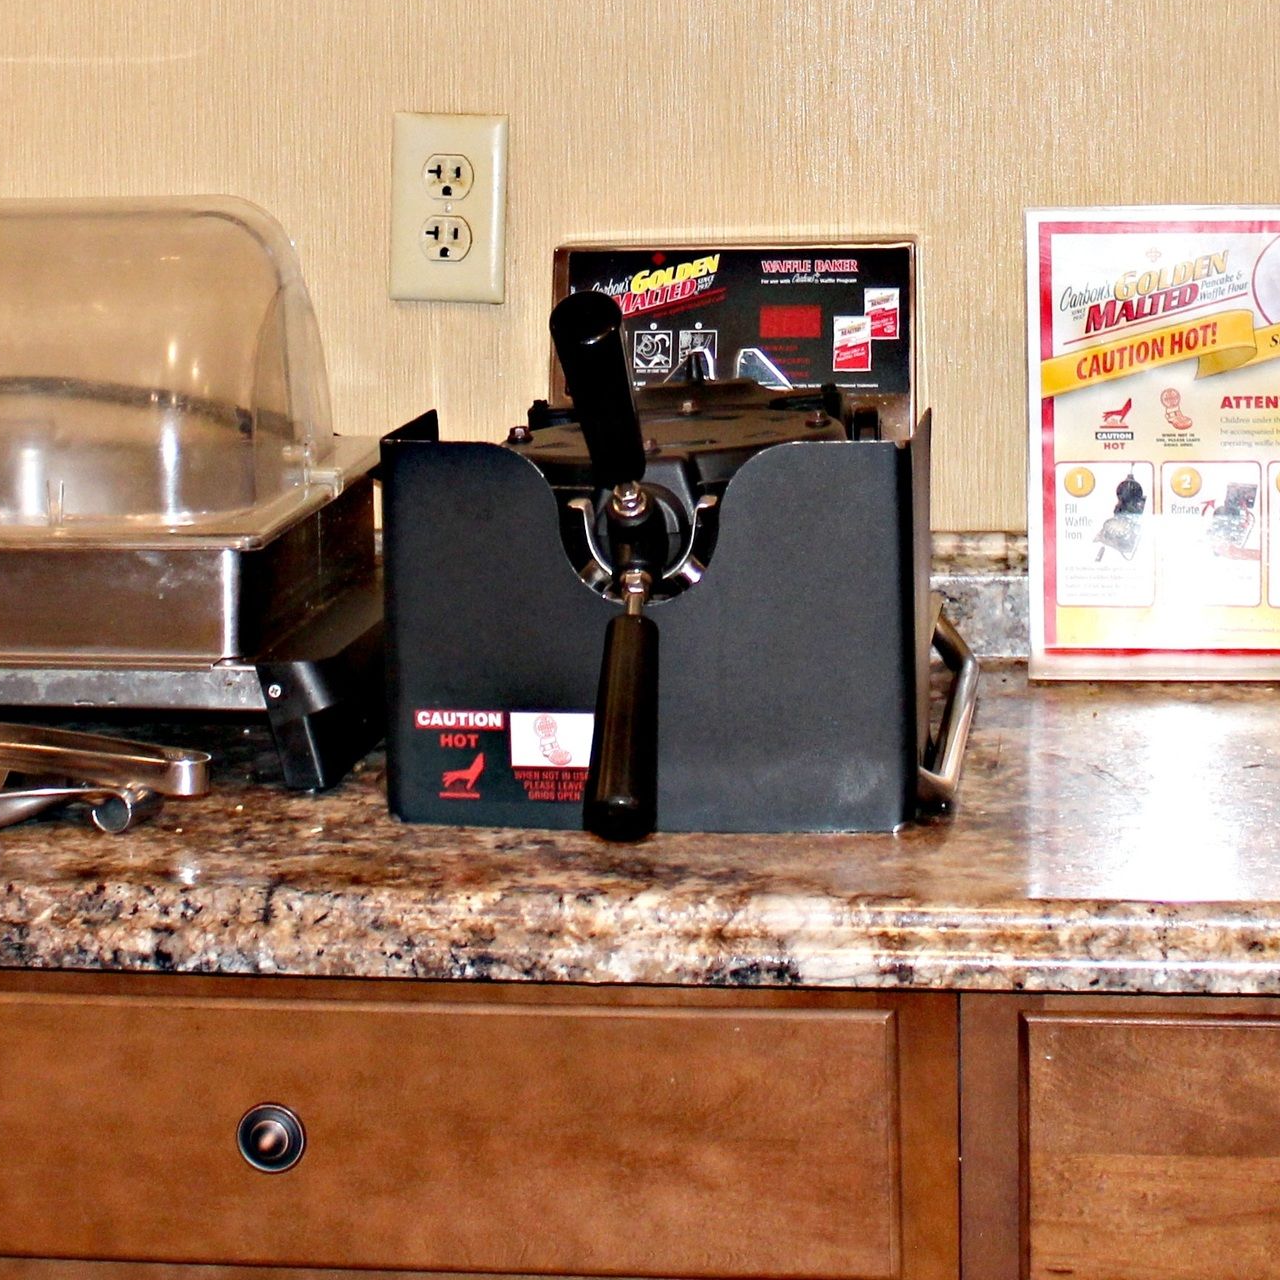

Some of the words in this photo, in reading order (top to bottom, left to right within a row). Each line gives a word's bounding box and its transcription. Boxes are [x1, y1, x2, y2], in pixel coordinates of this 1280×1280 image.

[761, 260, 812, 273] WAFFLE
[814, 259, 858, 272] BAKER
[630, 253, 721, 294] GOLDEN
[1060, 278, 1111, 312] Carbon's
[1114, 250, 1229, 301] GOLDEN
[1201, 275, 1234, 289] Pancake
[1199, 288, 1226, 302] Waffle
[1228, 281, 1249, 294] Flour
[1085, 282, 1199, 334] MALTED
[1076, 336, 1164, 380] CAUTION
[1170, 322, 1217, 356] HOT!
[1104, 442, 1126, 450] HOT
[1076, 475, 1084, 489] 1
[1180, 474, 1192, 489] 2
[1064, 504, 1078, 514] Fill
[1171, 504, 1200, 514] Rotate
[1065, 516, 1093, 528] Waffle
[1065, 530, 1082, 540] Iron
[417, 711, 502, 727] CAUTION
[440, 733, 479, 748] HOT
[515, 771, 540, 780] WHEN
[542, 771, 559, 780] NOT
[562, 771, 570, 780] IN
[524, 781, 555, 790] PLEASE
[559, 781, 583, 790] LEAVE
[557, 791, 580, 800] OPEN
